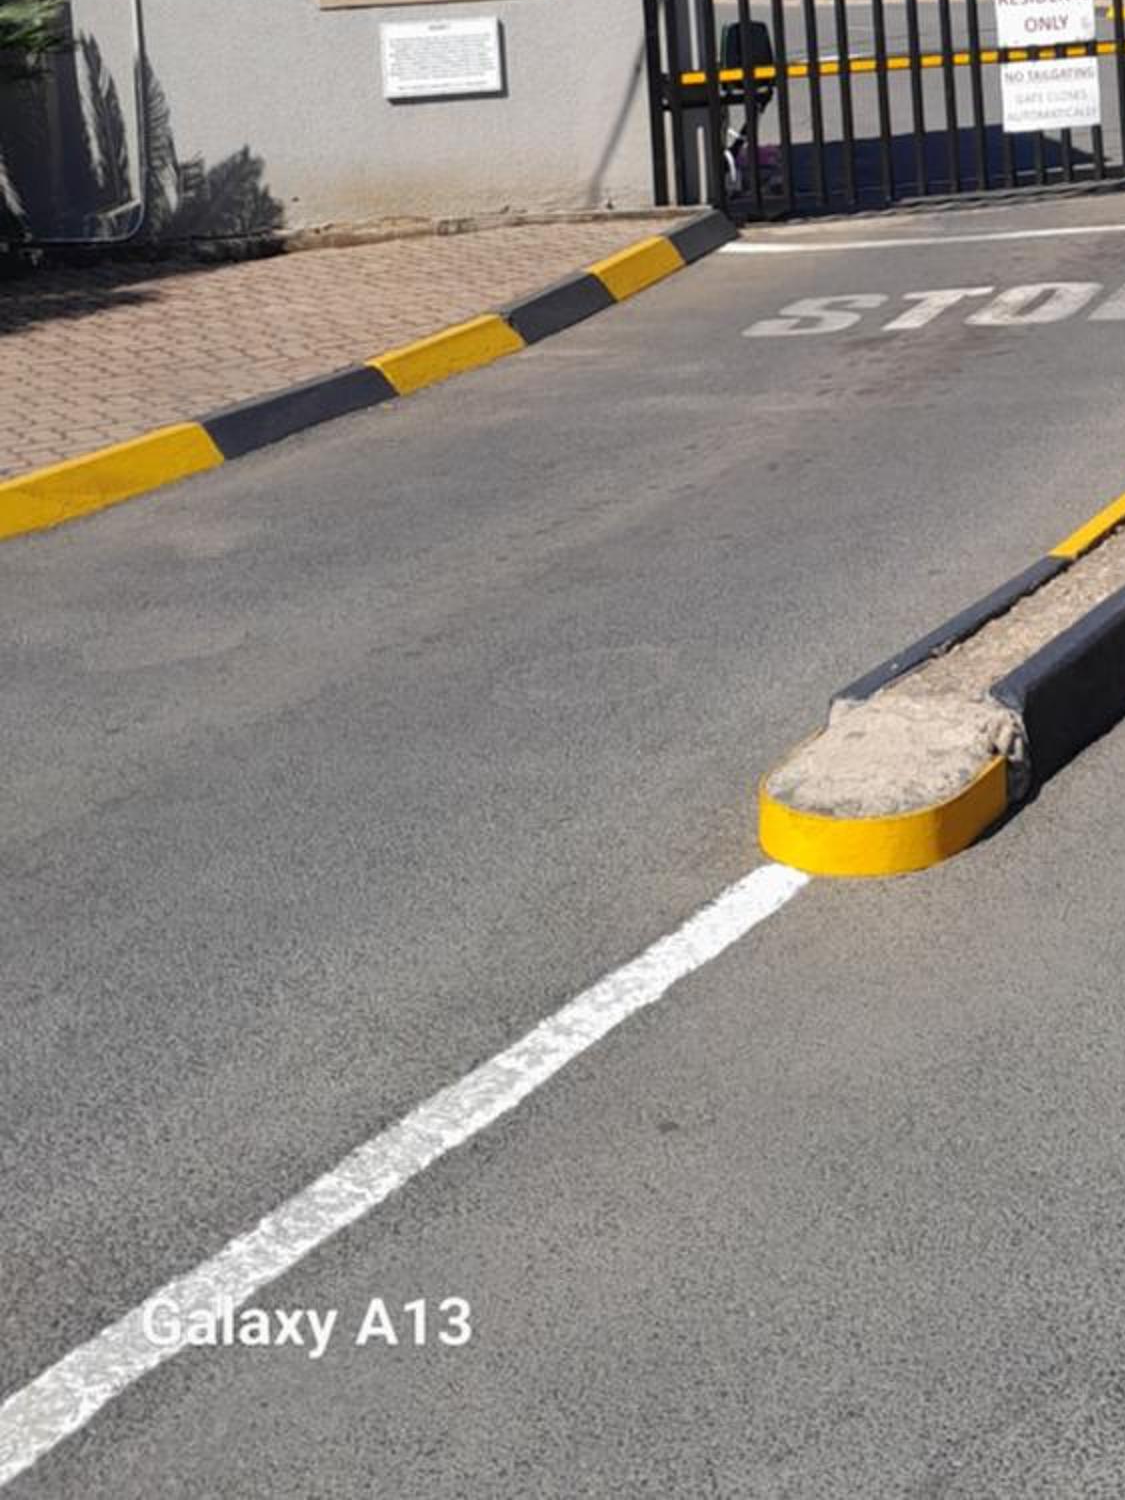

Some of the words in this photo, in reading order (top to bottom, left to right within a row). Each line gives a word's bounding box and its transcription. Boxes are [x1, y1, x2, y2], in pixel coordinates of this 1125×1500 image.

[1024, 15, 1069, 32] ONLY
[1004, 70, 1025, 84] NO
[1027, 66, 1095, 83] TAILGATING
